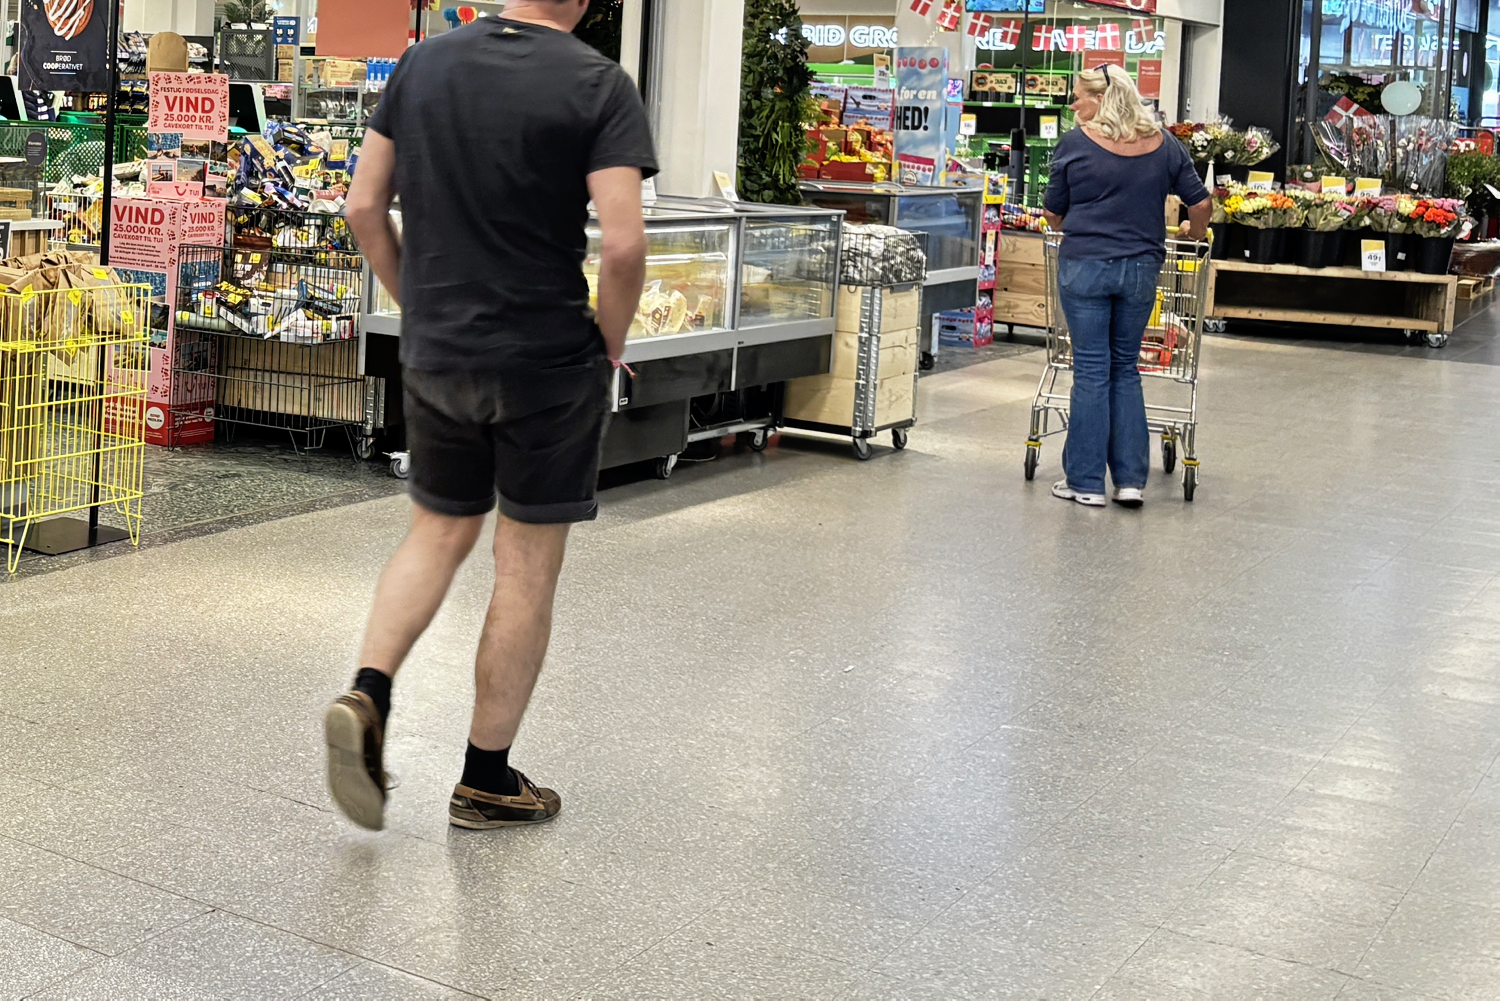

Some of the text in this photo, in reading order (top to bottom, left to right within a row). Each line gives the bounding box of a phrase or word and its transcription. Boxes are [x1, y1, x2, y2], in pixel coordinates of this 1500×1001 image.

[43, 62, 83, 71] COOPERATIVET
[900, 86, 938, 100] for en
[164, 95, 215, 114] VIND
[164, 113, 215, 124] 25.000 KR.
[113, 204, 165, 225] VIND
[189, 212, 216, 225] VIND
[113, 223, 164, 236] 25.000 KR.
[113, 233, 143, 242] GAVEKORT
